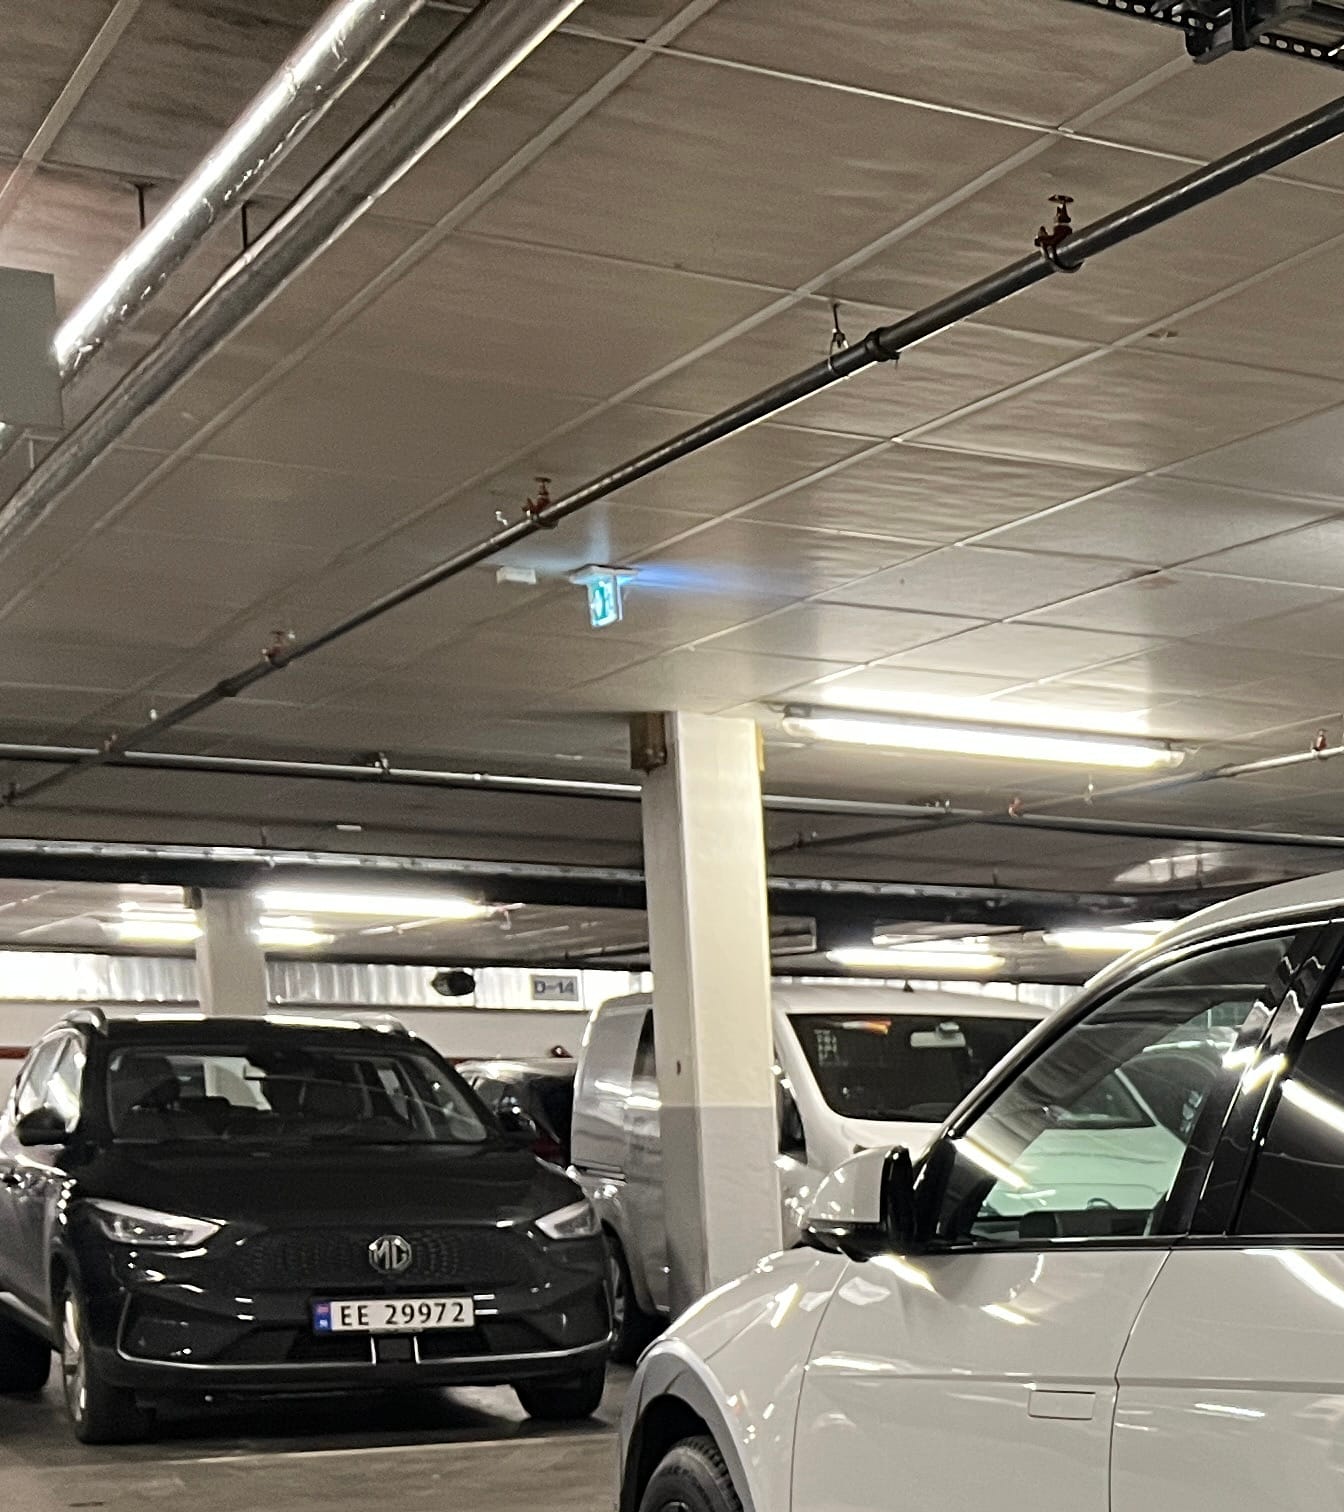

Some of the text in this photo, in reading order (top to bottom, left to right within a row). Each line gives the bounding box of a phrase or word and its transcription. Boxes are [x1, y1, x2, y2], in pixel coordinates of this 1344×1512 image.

[534, 980, 574, 994] D-14
[370, 1236, 412, 1272] MG
[340, 1302, 465, 1327] EE 29972
